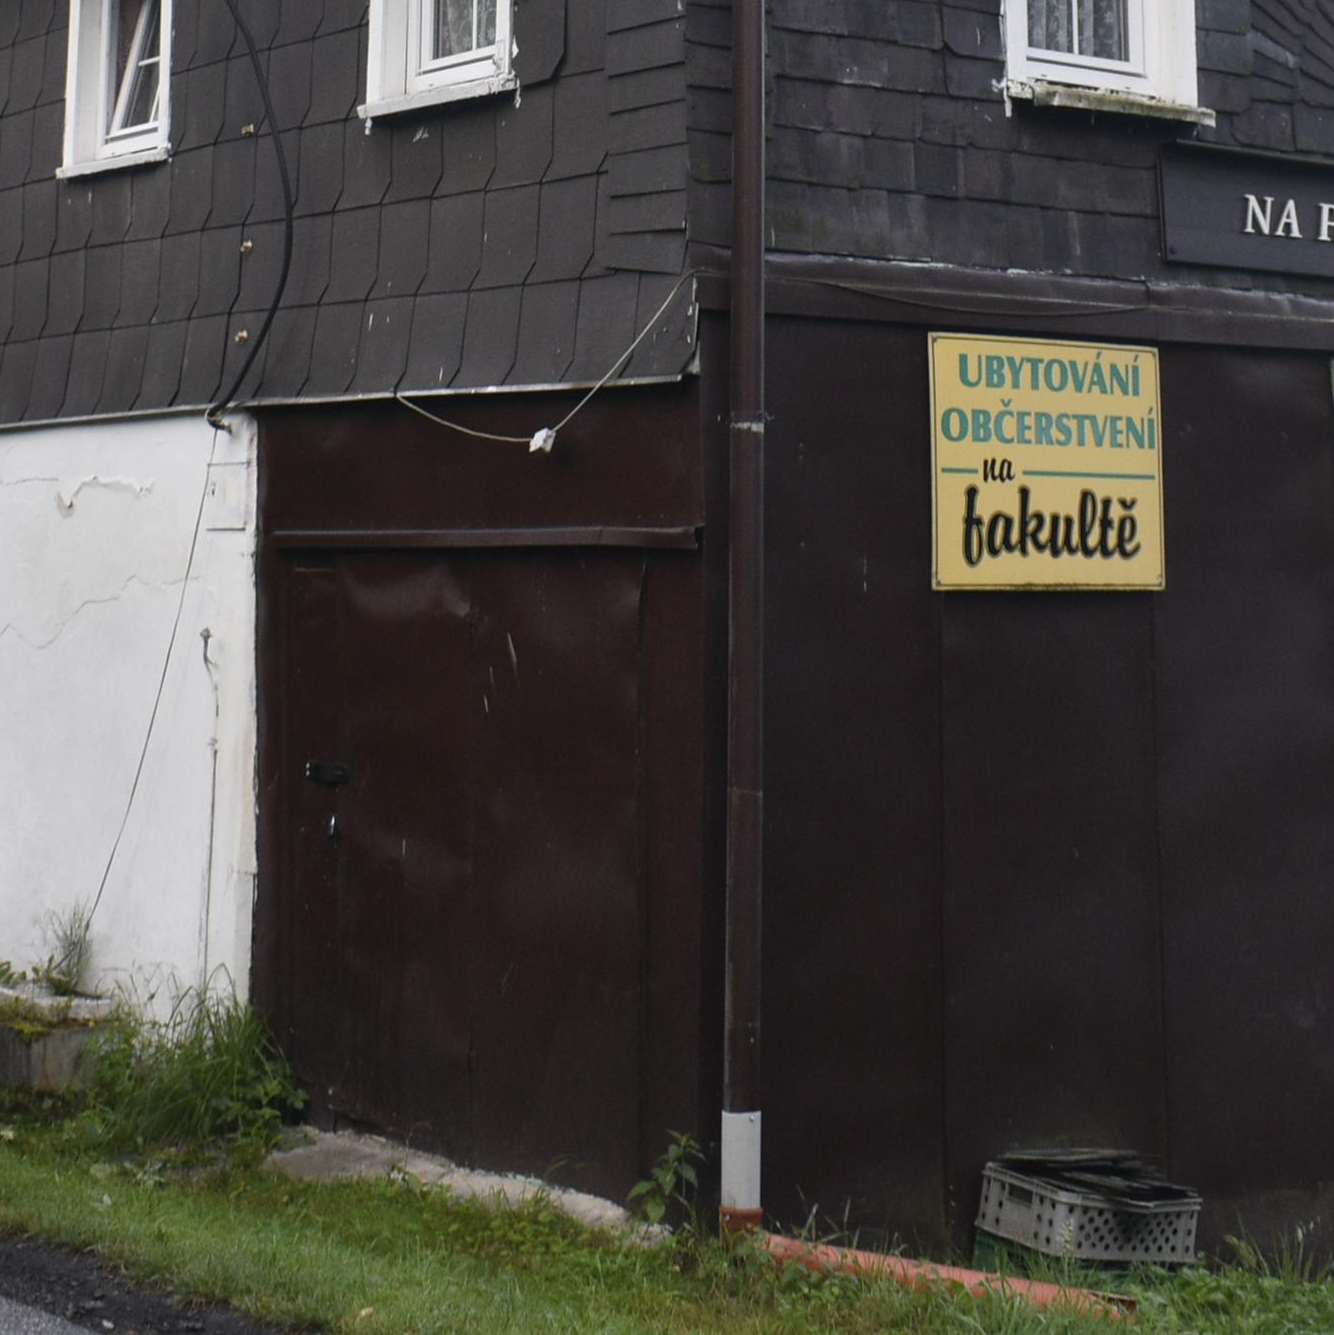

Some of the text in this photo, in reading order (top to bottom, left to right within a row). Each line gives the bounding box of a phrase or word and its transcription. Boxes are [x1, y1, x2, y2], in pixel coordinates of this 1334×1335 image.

[1243, 193, 1303, 239] NA
[958, 351, 1141, 397] UBYTOVÁNÍ
[940, 398, 1156, 449] OBČERSTVENÍ
[983, 457, 1015, 483] na
[962, 484, 1141, 568] fakultě
